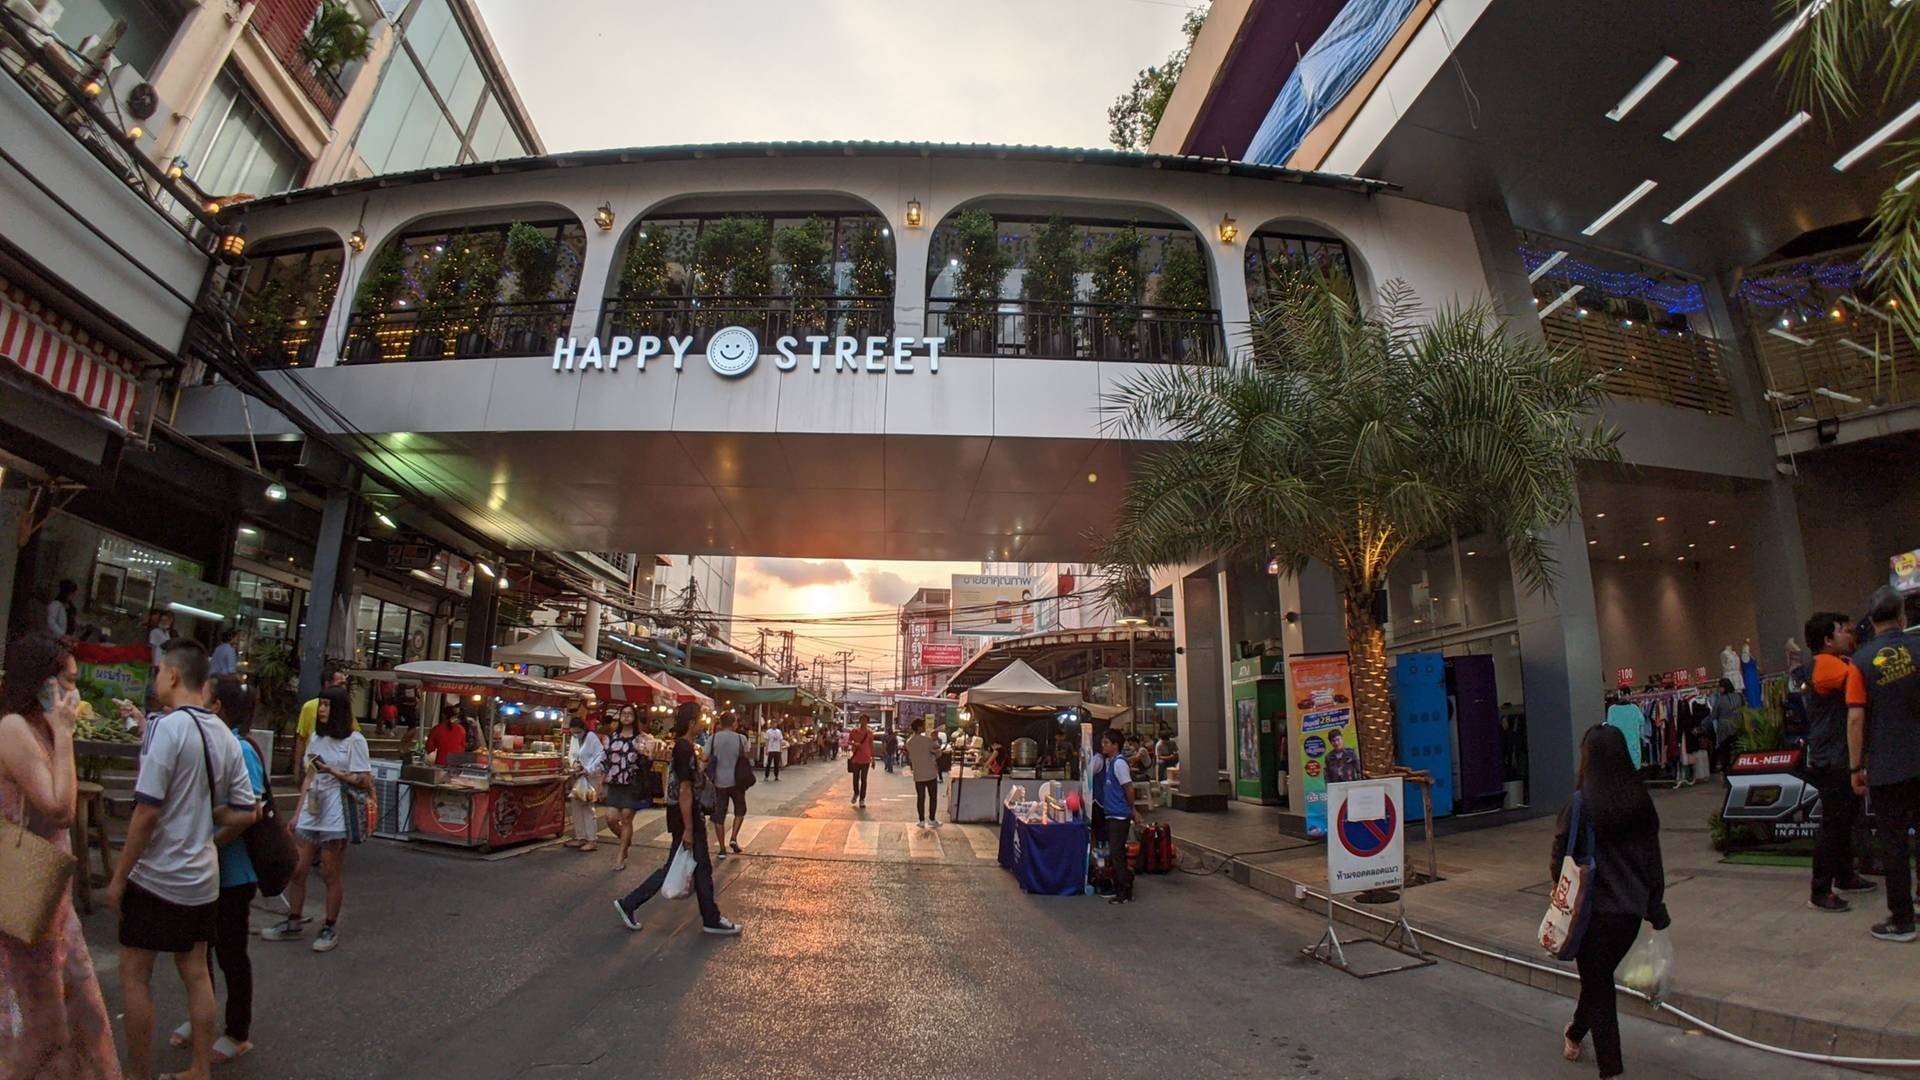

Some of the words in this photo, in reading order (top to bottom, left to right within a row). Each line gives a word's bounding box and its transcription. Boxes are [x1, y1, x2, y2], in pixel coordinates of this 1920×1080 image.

[551, 334, 694, 372] HAPPY
[774, 334, 946, 374] STREET
[1738, 754, 1791, 766] ALL-NEW
[1774, 829, 1814, 837] INFINI
[1336, 865, 1399, 880] ห้ามจอดตลอดแนว
